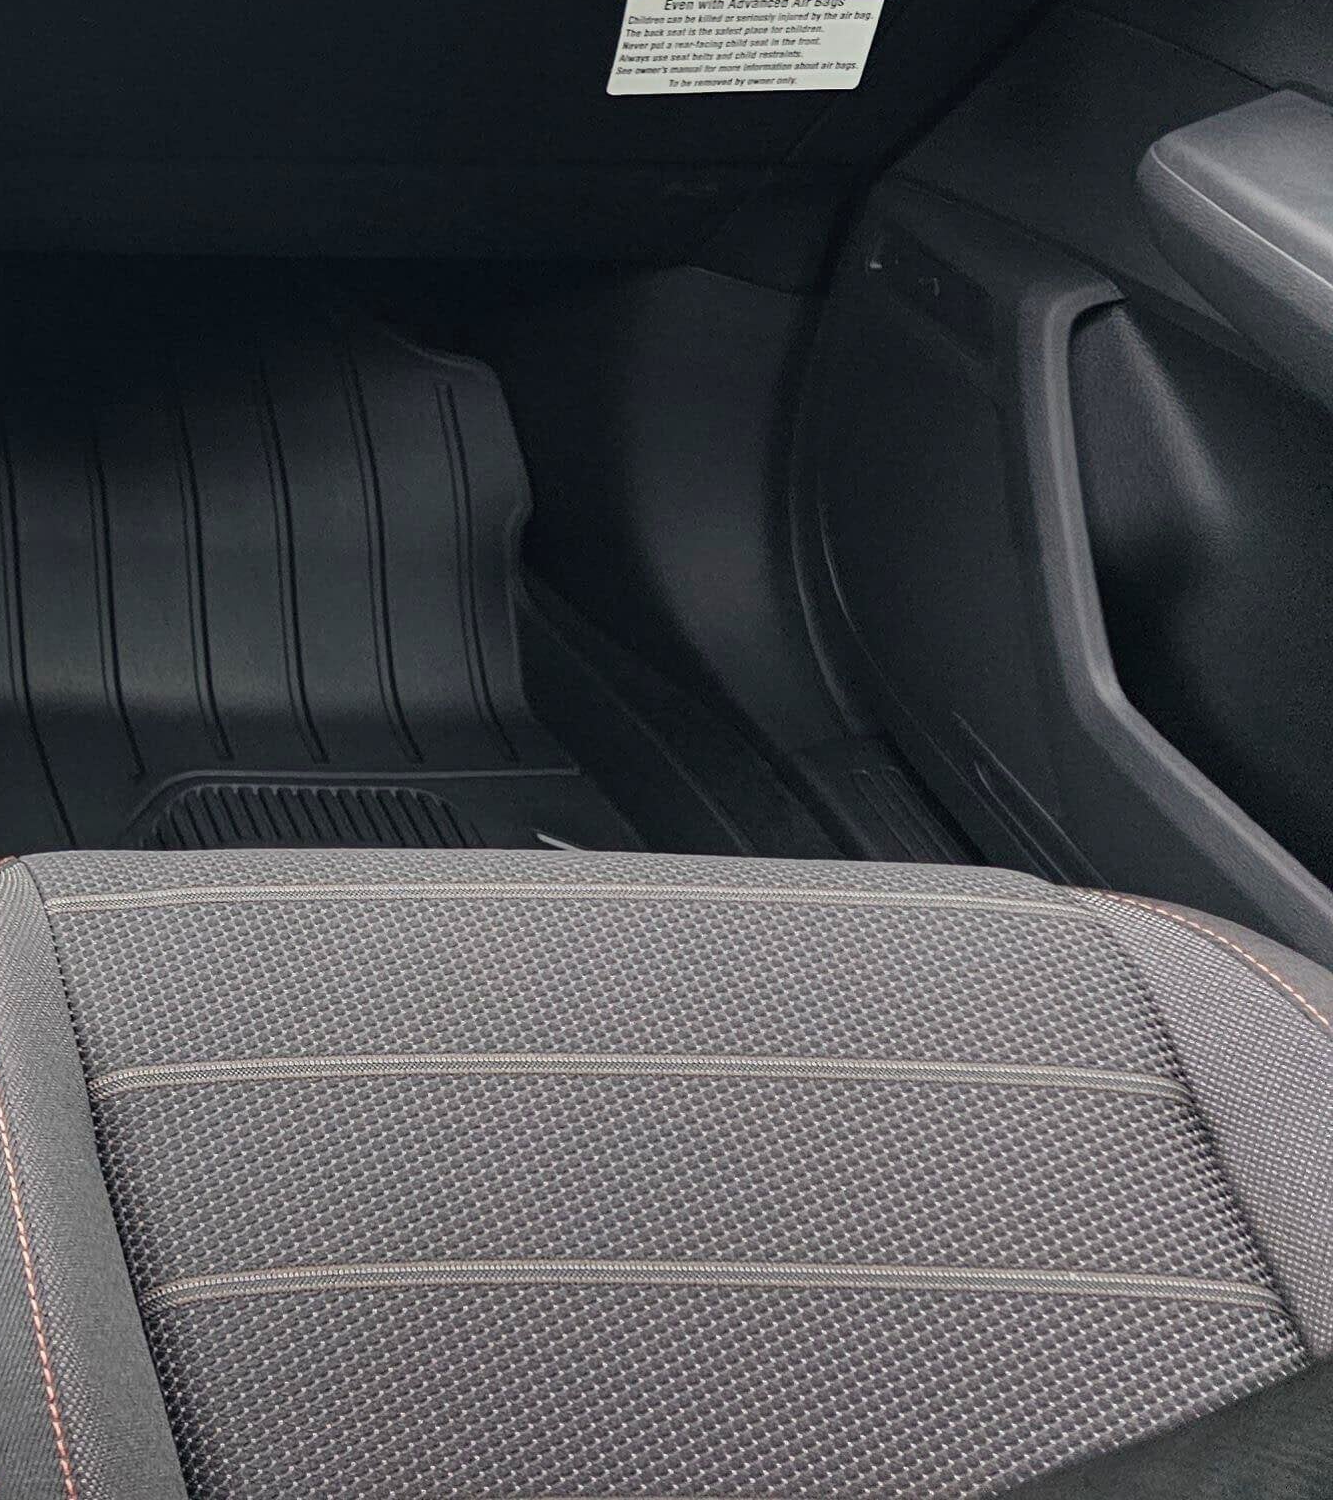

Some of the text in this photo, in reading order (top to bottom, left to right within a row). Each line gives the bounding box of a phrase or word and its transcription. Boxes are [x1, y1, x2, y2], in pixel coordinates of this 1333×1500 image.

[628, 15, 666, 25] Children
[684, 15, 696, 24] be
[698, 14, 723, 23] killed
[724, 15, 735, 23] or
[736, 14, 776, 23] seriously
[777, 12, 810, 22] injured
[811, 12, 821, 21] by
[824, 12, 838, 20] the
[840, 12, 853, 20] air
[854, 11, 874, 21] bag.
[626, 25, 825, 37] The back seat is the safest place for children.
[622, 41, 648, 50] Never
[650, 41, 665, 51] put
[674, 40, 724, 49] rear-facing
[725, 39, 747, 48] child
[749, 38, 769, 47] seat
[770, 38, 779, 46] in
[782, 38, 796, 46] the
[798, 37, 821, 46] front.
[619, 54, 650, 63] Always
[670, 53, 690, 62] seat
[692, 52, 713, 61] belts
[715, 52, 732, 60] and
[735, 51, 757, 60] child
[759, 50, 803, 59] restraints.
[616, 61, 859, 75] See owner's manual for more information about air bags.
[669, 76, 797, 88] To be removed by owner only.
